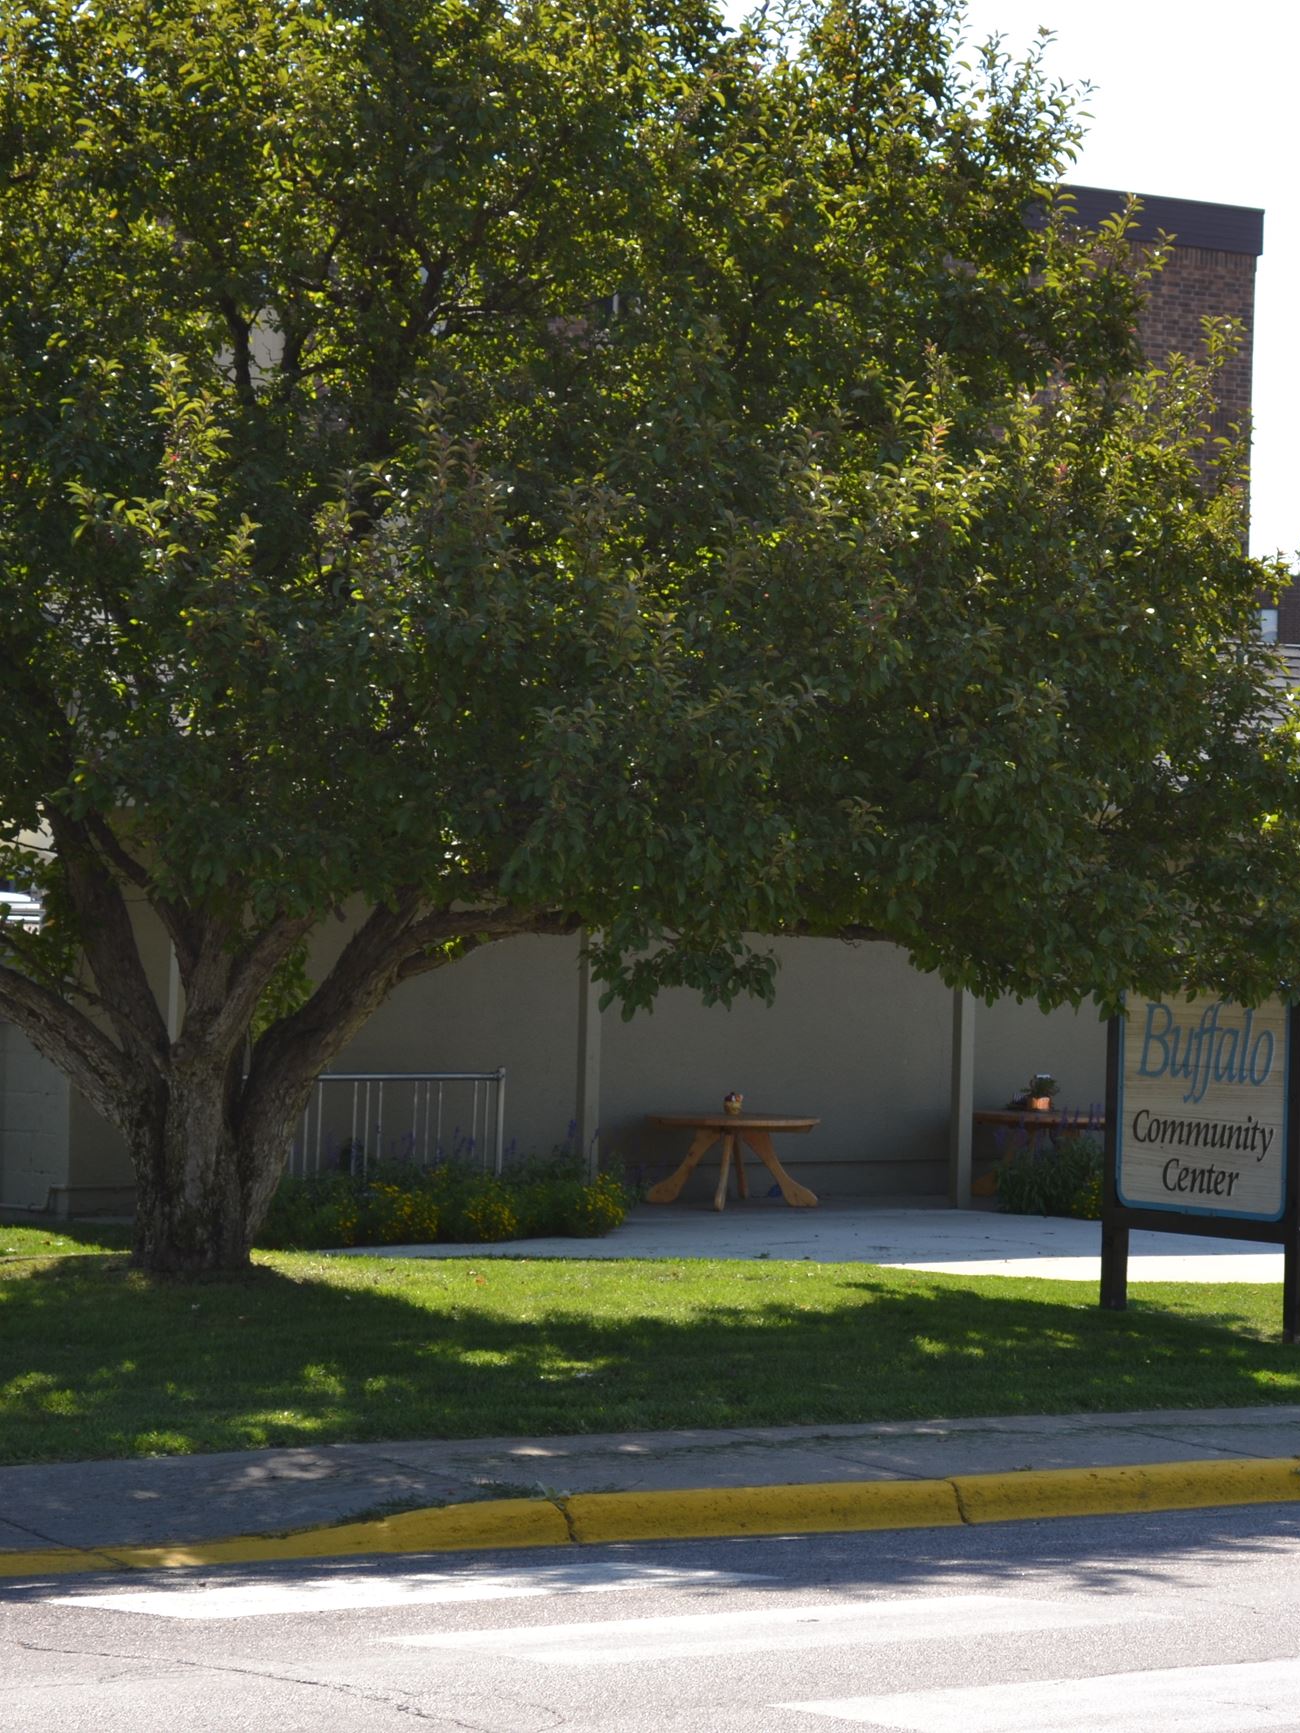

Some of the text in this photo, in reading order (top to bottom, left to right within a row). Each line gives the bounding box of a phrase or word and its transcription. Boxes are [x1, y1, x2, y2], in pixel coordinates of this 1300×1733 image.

[1136, 1000, 1275, 1103] Buffalo
[1132, 1109, 1274, 1162] Community
[1162, 1158, 1240, 1197] Center
